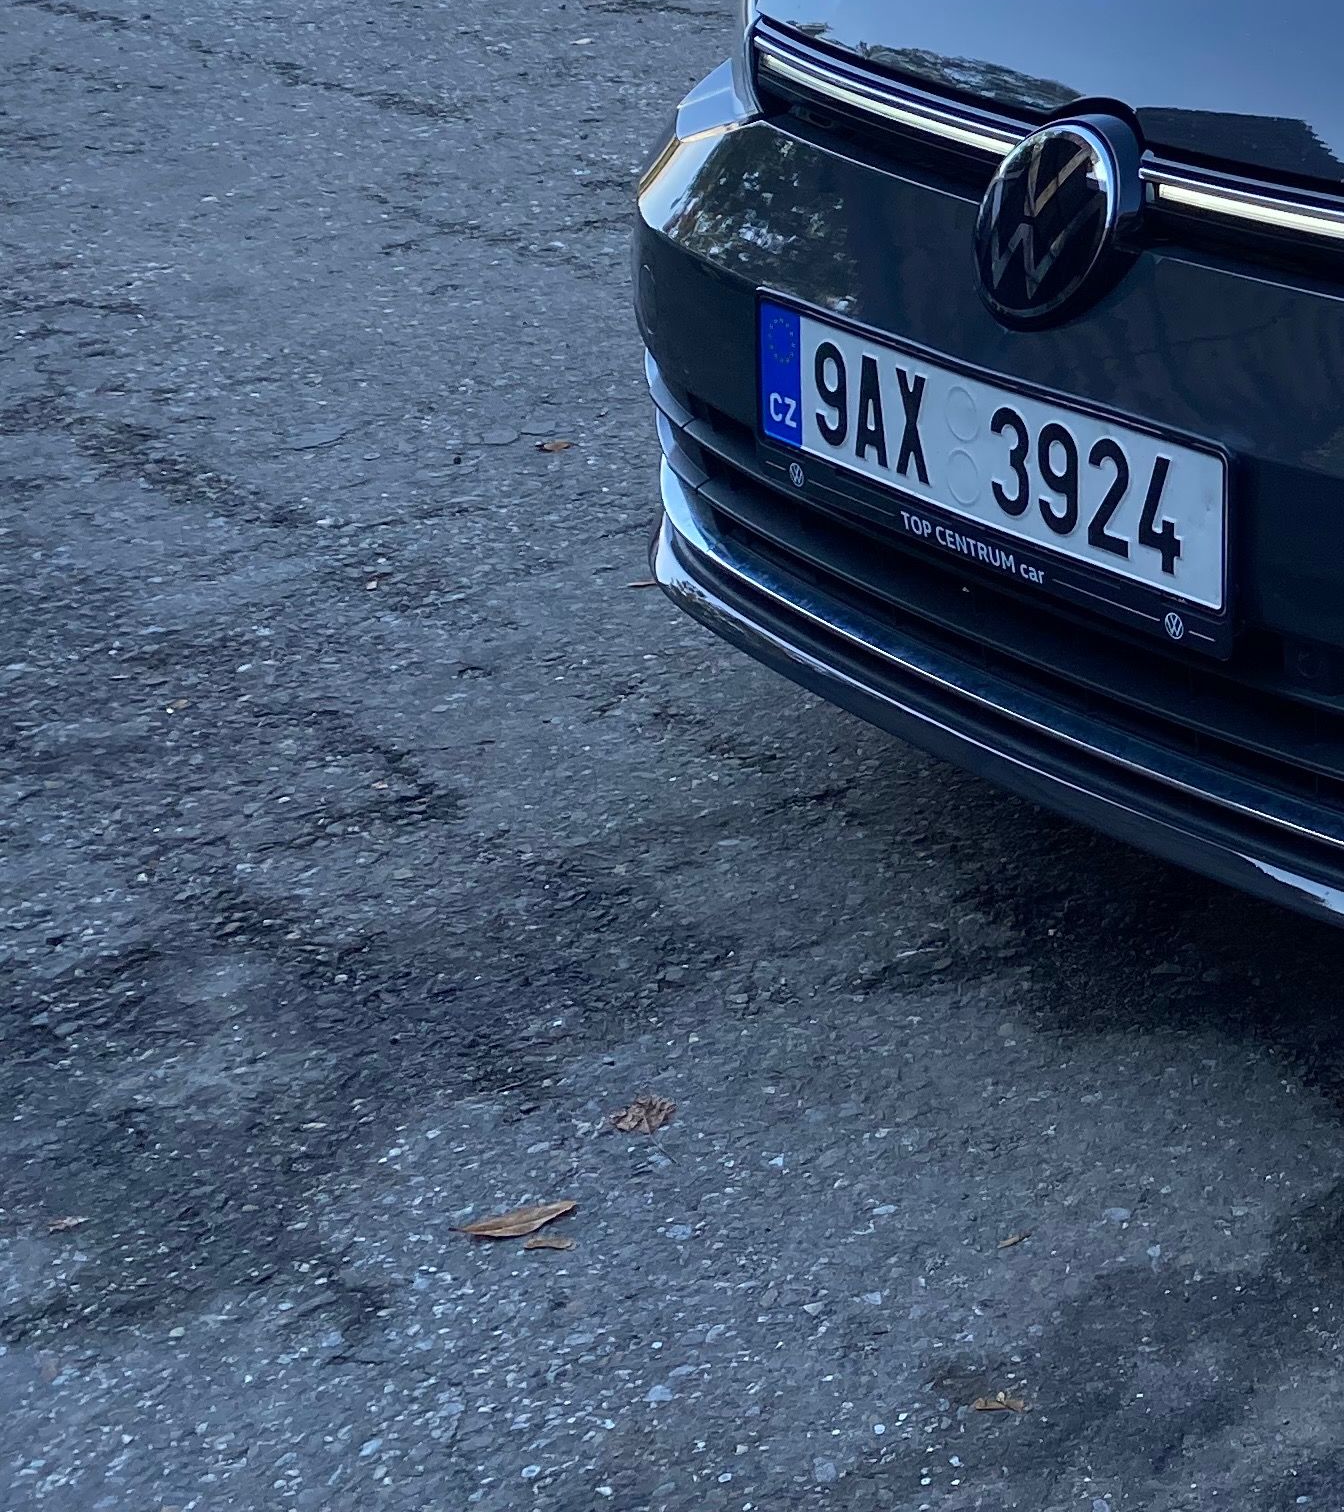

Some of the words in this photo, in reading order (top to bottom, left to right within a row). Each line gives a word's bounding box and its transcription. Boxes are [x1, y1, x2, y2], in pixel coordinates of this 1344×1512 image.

[977, 126, 1113, 318] VW
[769, 392, 798, 429] CZ
[814, 341, 931, 487] 9AX
[990, 406, 1181, 576] 3924
[900, 510, 932, 538] TOP
[935, 525, 1016, 574] CENTRUM
[1019, 563, 1045, 585] car
